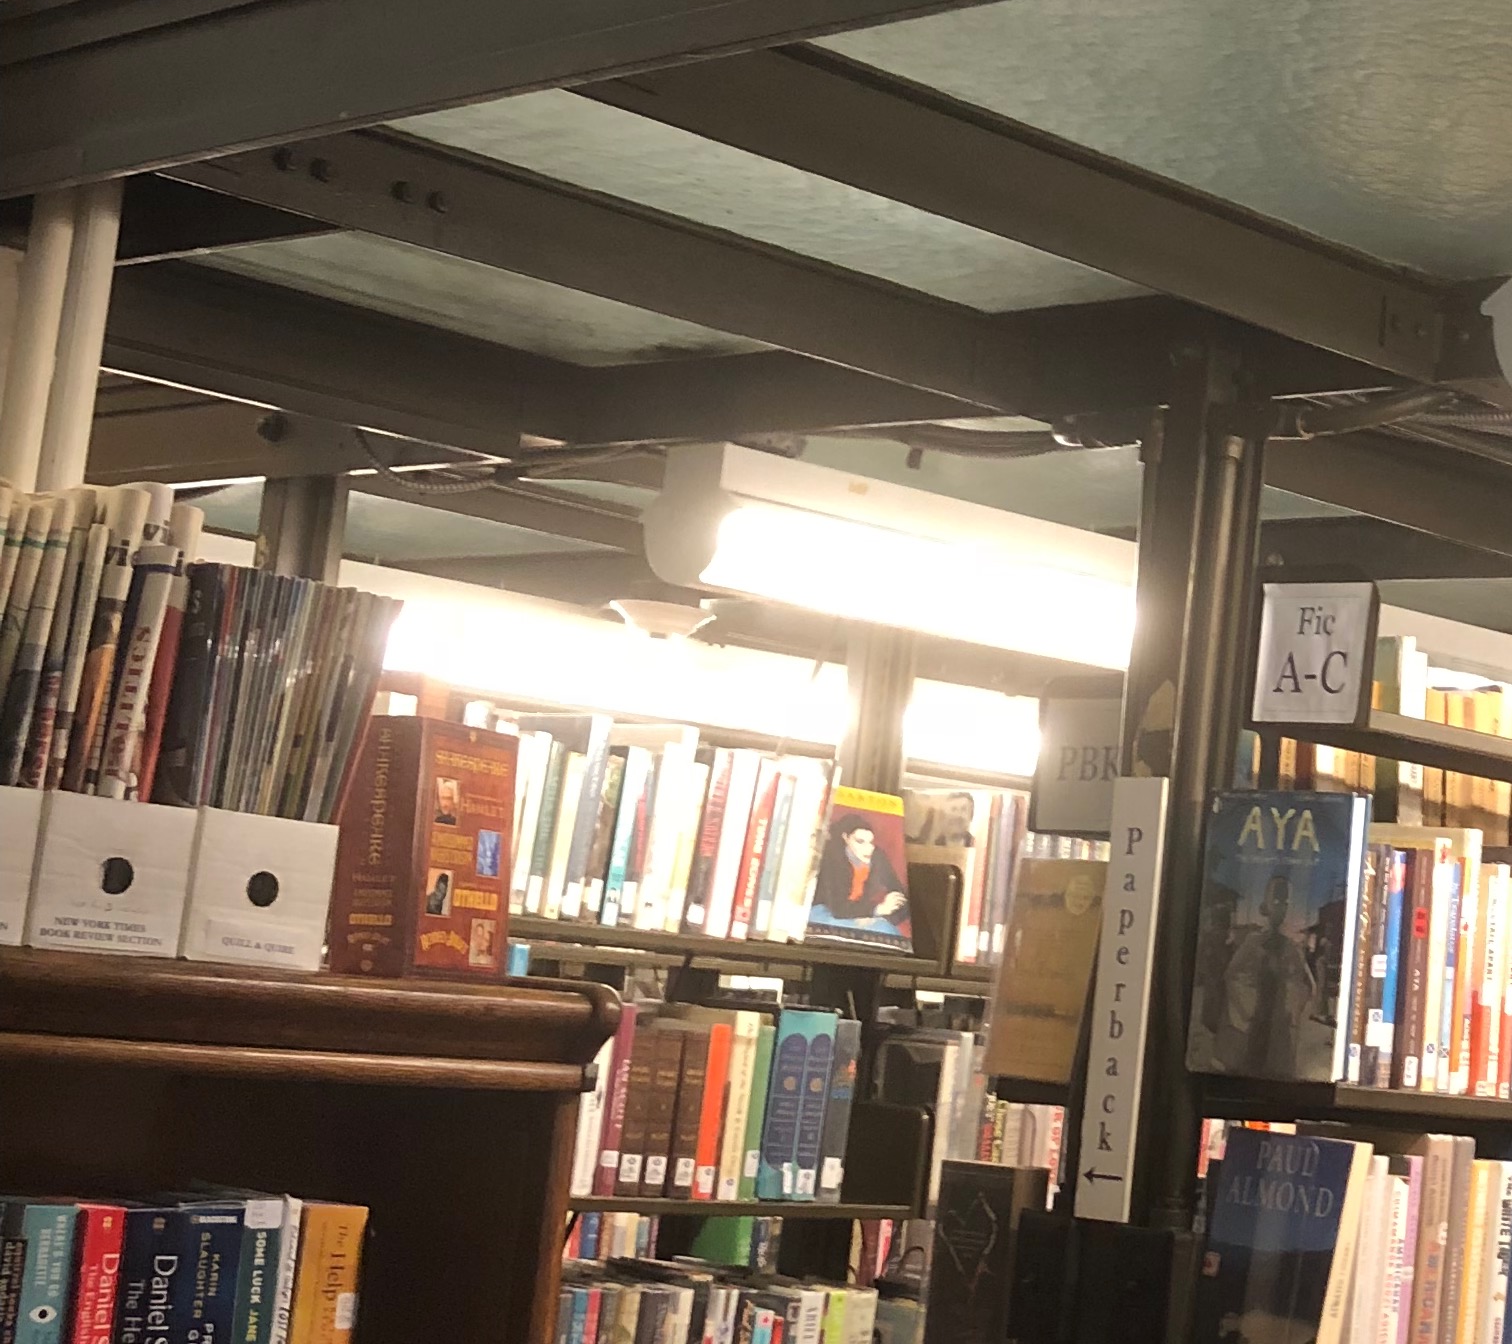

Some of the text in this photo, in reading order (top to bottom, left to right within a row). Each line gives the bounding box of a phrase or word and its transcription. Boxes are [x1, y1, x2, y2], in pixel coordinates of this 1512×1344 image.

[1298, 606, 1335, 637] Fic
[1272, 651, 1348, 695] A-C
[1058, 746, 1119, 781] PBK
[1237, 805, 1321, 854] AYA
[39, 927, 163, 947] BOOK REVIEW SECTION
[54, 915, 147, 934] NEW YORK TIMES
[221, 935, 252, 949] QUILL
[1098, 825, 1144, 1153] Paperback
[1256, 1139, 1320, 1177] PAUL
[1226, 1175, 1335, 1219] ALMOND
[253, 1232, 267, 1267] SOME
[92, 1253, 121, 1330] Daniel
[146, 1256, 179, 1331] Daniel
[192, 1231, 213, 1319] SLAUGHTER
[207, 1253, 221, 1297] KARIN
[249, 1270, 262, 1304] LUCK
[322, 1252, 346, 1302] Help
[126, 1280, 145, 1310] The
[245, 1308, 259, 1343] JANE
